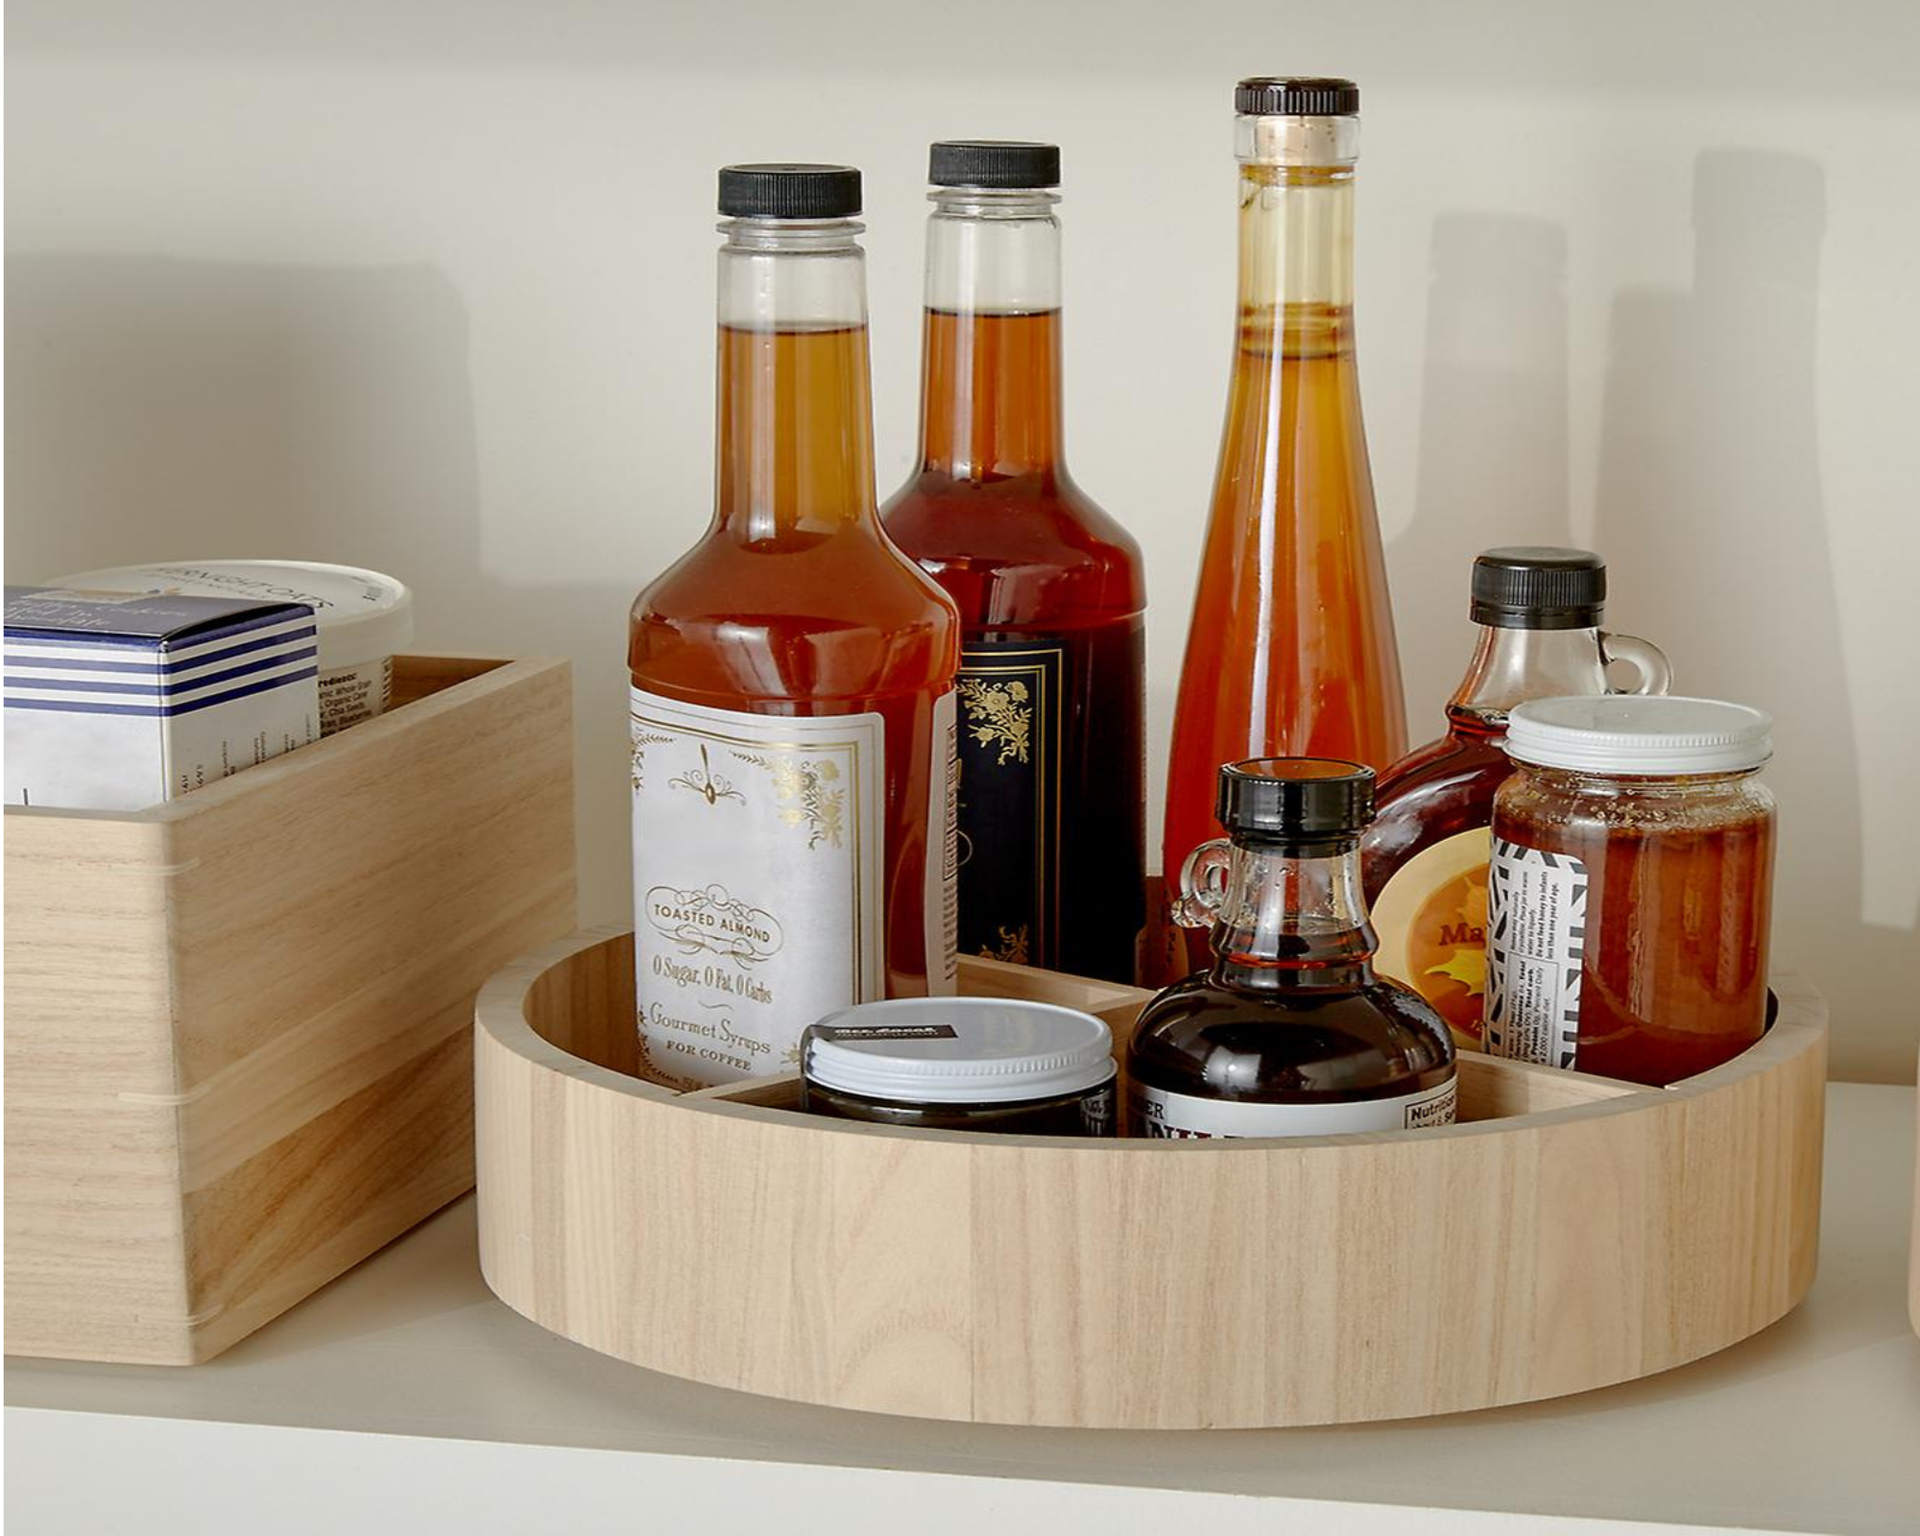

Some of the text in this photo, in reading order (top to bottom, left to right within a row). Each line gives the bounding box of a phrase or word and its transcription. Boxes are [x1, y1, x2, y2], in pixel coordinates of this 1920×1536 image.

[654, 904, 771, 943] TOASTED ALMOND
[1538, 902, 1548, 920] honey
[1438, 922, 1486, 949] Ma
[1545, 948, 1553, 959] less
[1550, 904, 1558, 919] year
[745, 976, 773, 1004] Carbs
[1535, 968, 1543, 984] Daily
[650, 1001, 771, 1056] Gourmet Syrups
[666, 1040, 752, 1071] FOR COFFEE
